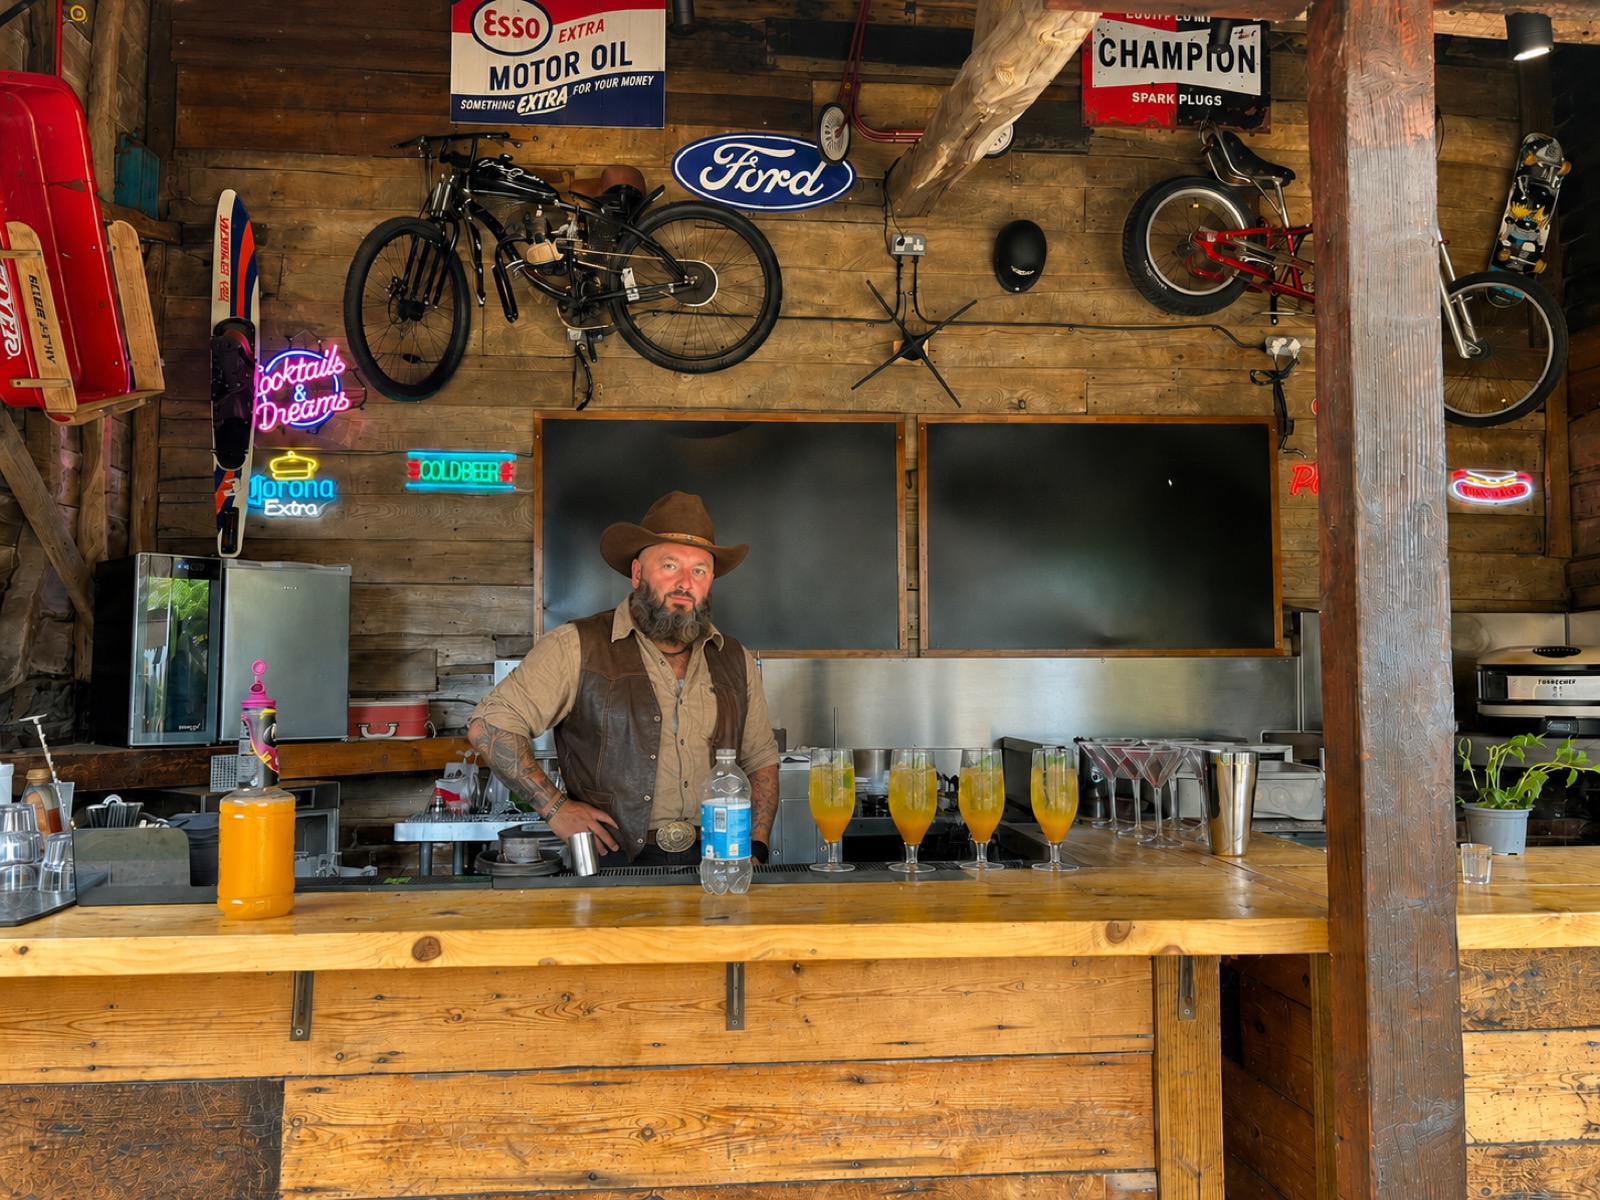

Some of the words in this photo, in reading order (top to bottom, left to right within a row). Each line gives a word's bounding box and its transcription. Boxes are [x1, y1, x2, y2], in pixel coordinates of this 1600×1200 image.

[558, 18, 605, 44] EXTRA
[489, 51, 580, 91] MOTOR
[591, 41, 633, 71] OIL
[1098, 38, 1256, 73] CHAMPION
[460, 99, 515, 110] SOMETHING
[516, 86, 568, 114] EXTRA
[572, 82, 591, 95] FOR
[594, 78, 618, 90] YOUR
[621, 75, 654, 87] MONEY
[1132, 92, 1175, 104] SPARK
[1179, 94, 1222, 106] PLUGS
[699, 143, 828, 197] Ford
[258, 344, 346, 397] ocktails
[256, 391, 350, 431] Dreams
[293, 383, 307, 402] &
[264, 498, 318, 516] Extra
